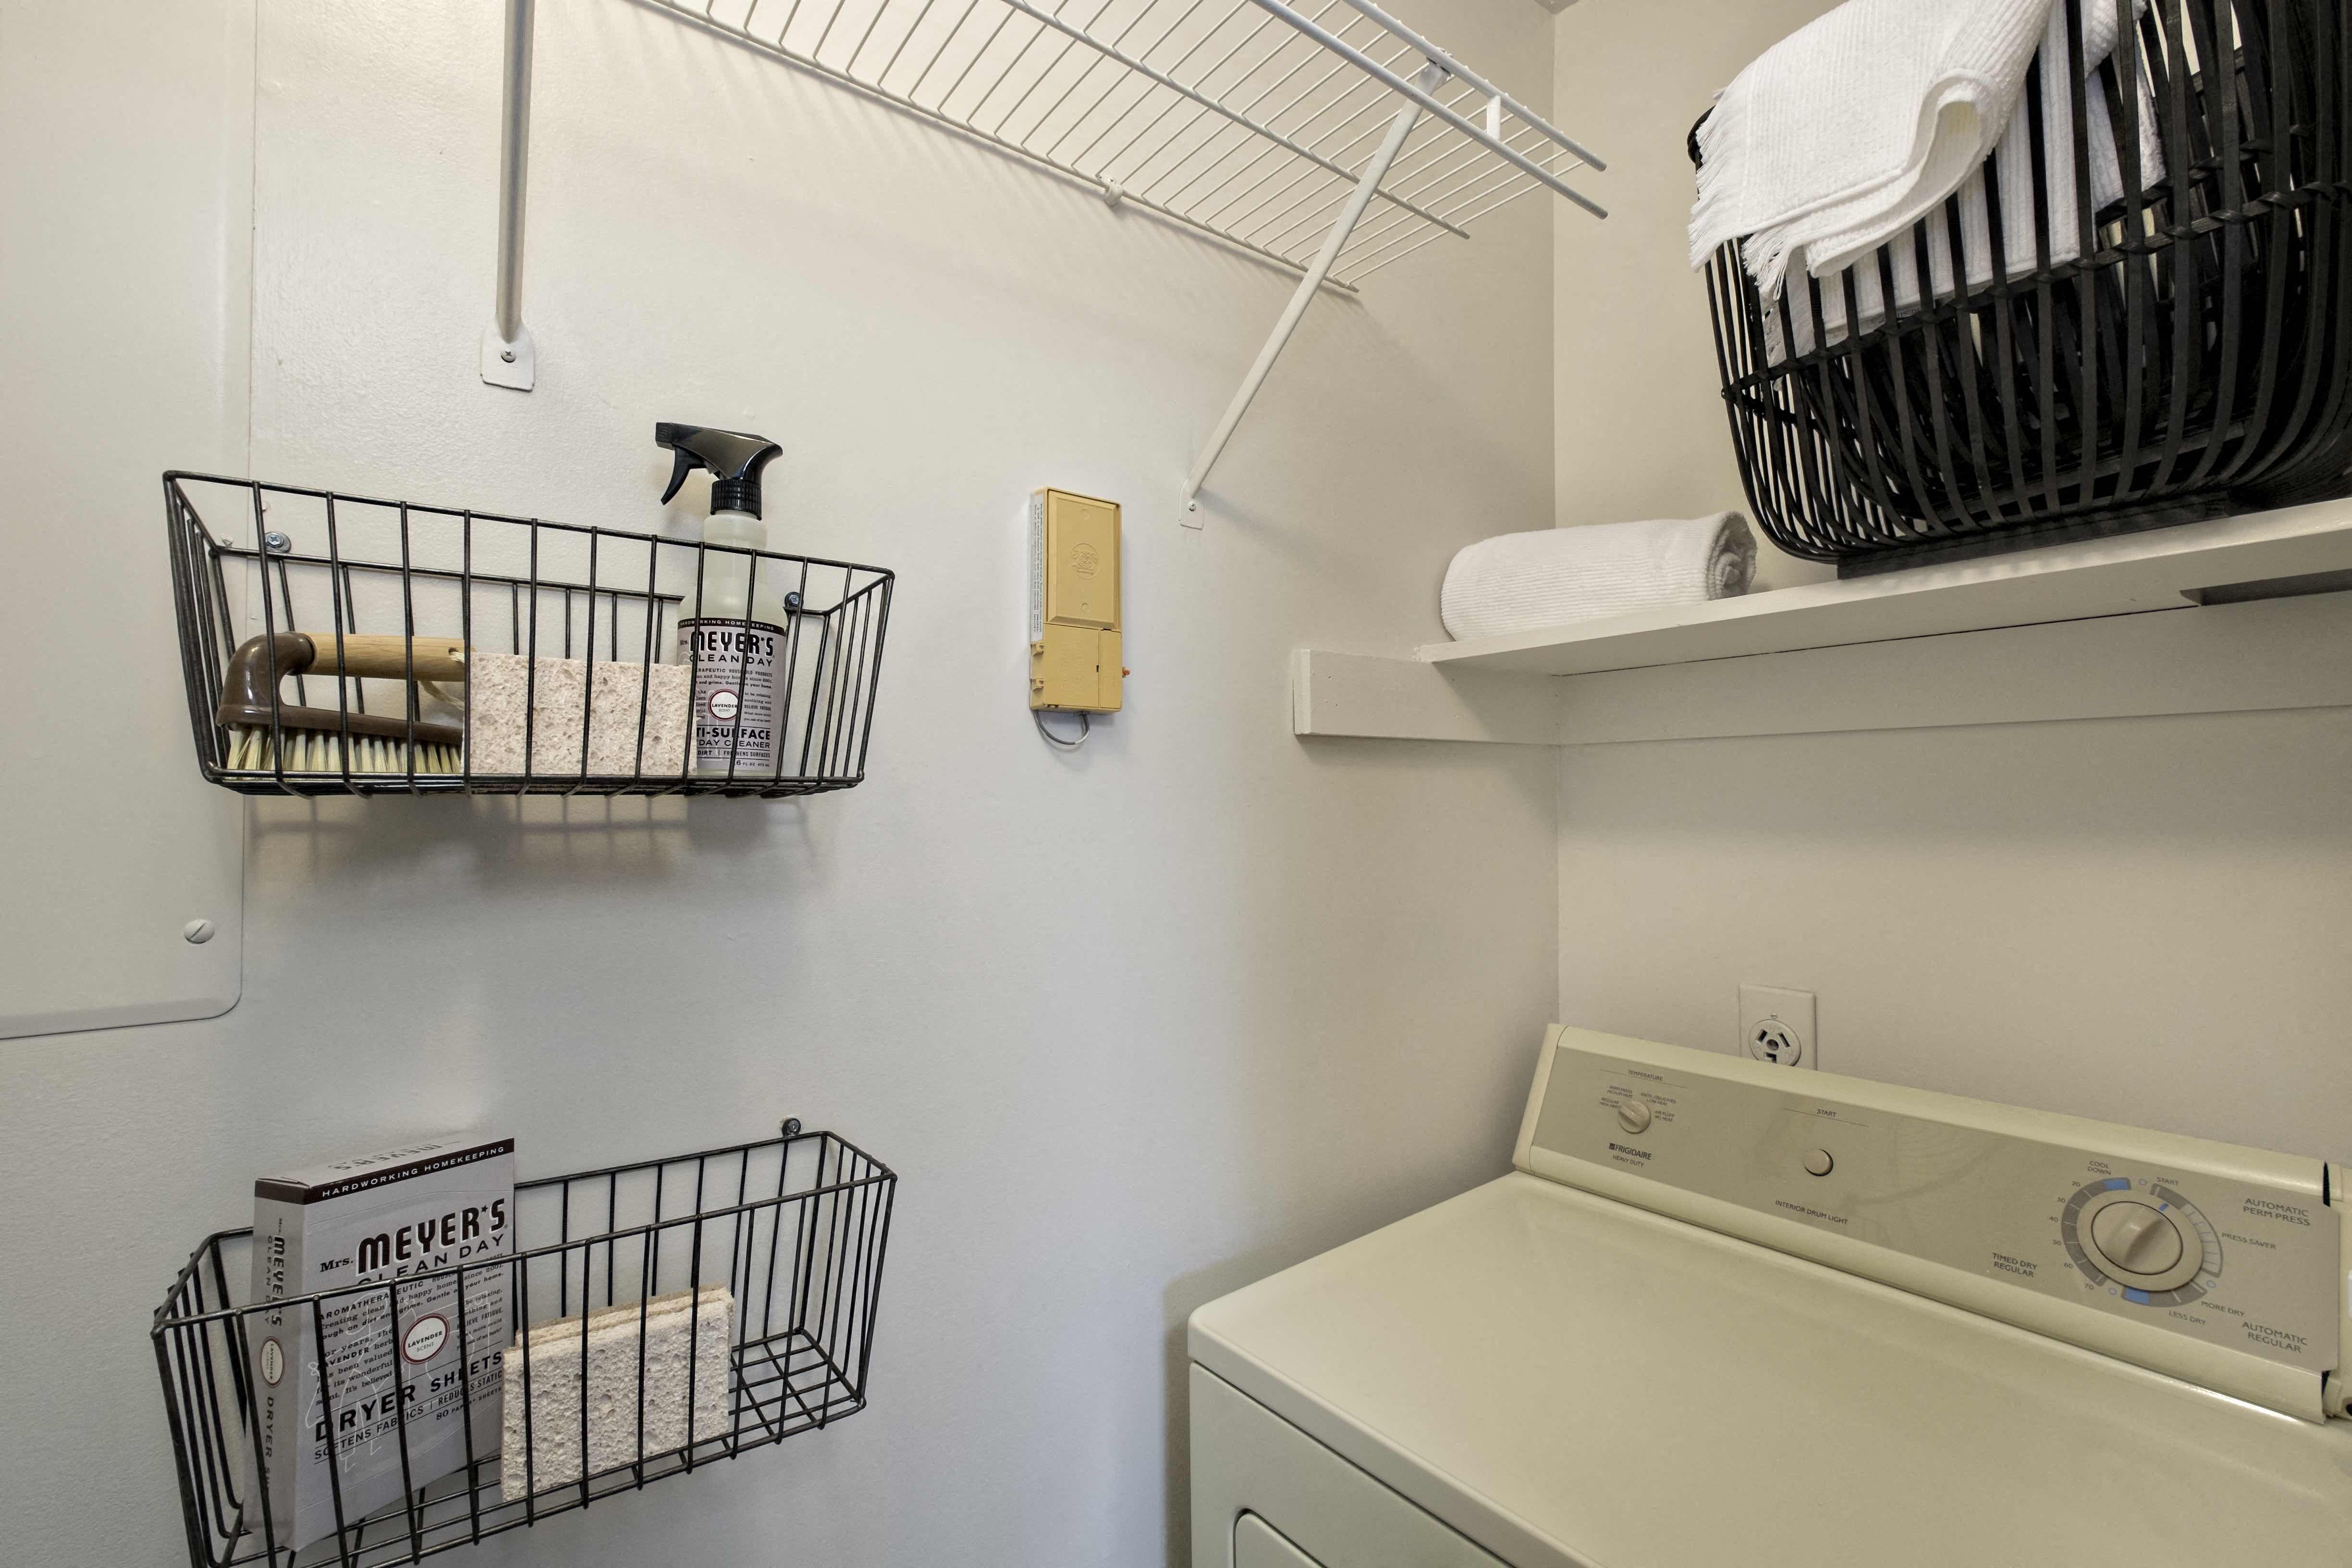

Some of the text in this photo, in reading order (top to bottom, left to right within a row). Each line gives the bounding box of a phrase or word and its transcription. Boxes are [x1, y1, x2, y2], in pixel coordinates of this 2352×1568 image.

[725, 621, 774, 630] HOMEEEPING
[690, 631, 773, 657] MEYER'S
[747, 656, 773, 667] DAY
[697, 727, 771, 740] TI-SUFACE
[724, 740, 771, 748] CEANER
[1628, 1069, 1664, 1081] TEMPERATURE
[1817, 1109, 1837, 1118] START
[1612, 1154, 1644, 1167] HEAVY DUTY
[1615, 1144, 1653, 1161] FRIGIDAIRE
[322, 1146, 504, 1197] HARDWORKING HOMEKEEPING
[2087, 1166, 2111, 1176] DOWN
[2089, 1161, 2110, 1169] COOL
[2156, 1177, 2180, 1186] START
[1775, 1200, 1849, 1225] INTERIOR DRUM LIGHT
[2243, 1206, 2310, 1226] PERM PRESS
[2245, 1198, 2309, 1217] AUTOMATIC
[320, 1198, 505, 1276] Mrs. MEYER'S
[459, 1234, 504, 1259] DAY
[2221, 1233, 2277, 1250] PRESS SAVER
[1992, 1252, 2038, 1271] TIMED DRY
[1994, 1261, 2034, 1278] REGULAR
[318, 1281, 424, 1321] AROMATHERAEUTIC
[362, 1305, 385, 1317] clean
[408, 1287, 433, 1300] happy
[436, 1280, 458, 1291] home
[464, 1271, 483, 1281] since
[490, 1297, 502, 1306] and
[322, 1329, 344, 1340] ough
[362, 1316, 377, 1326] dirt
[399, 1302, 423, 1314] grime.
[427, 1291, 450, 1303] Gentle
[465, 1280, 481, 1291] your
[483, 1273, 504, 1283] home.
[2201, 1300, 2245, 1317] MORE DRY
[2169, 1310, 2206, 1325] LESS DRY
[324, 1349, 337, 1358] or
[378, 1329, 393, 1338] the
[408, 1331, 443, 1348] LAVENDER
[2242, 1322, 2308, 1346] AUTOMATIC
[2248, 1332, 2302, 1353] REGULAR
[373, 1339, 393, 1350] herb
[416, 1342, 434, 1352] SCENT
[338, 1348, 393, 1374] been valued
[333, 1379, 345, 1388] its
[348, 1360, 393, 1382] wonderful
[345, 1385, 358, 1394] It's
[361, 1370, 393, 1387] believed
[377, 1406, 424, 1433] FABICS
[438, 1383, 475, 1406] REDUCS
[477, 1370, 502, 1388] STATIC
[436, 1409, 449, 1420] 80
[478, 1386, 502, 1400] SHEETS
[316, 1384, 416, 1442] DRYER
[265, 1396, 274, 1458] DRYER
